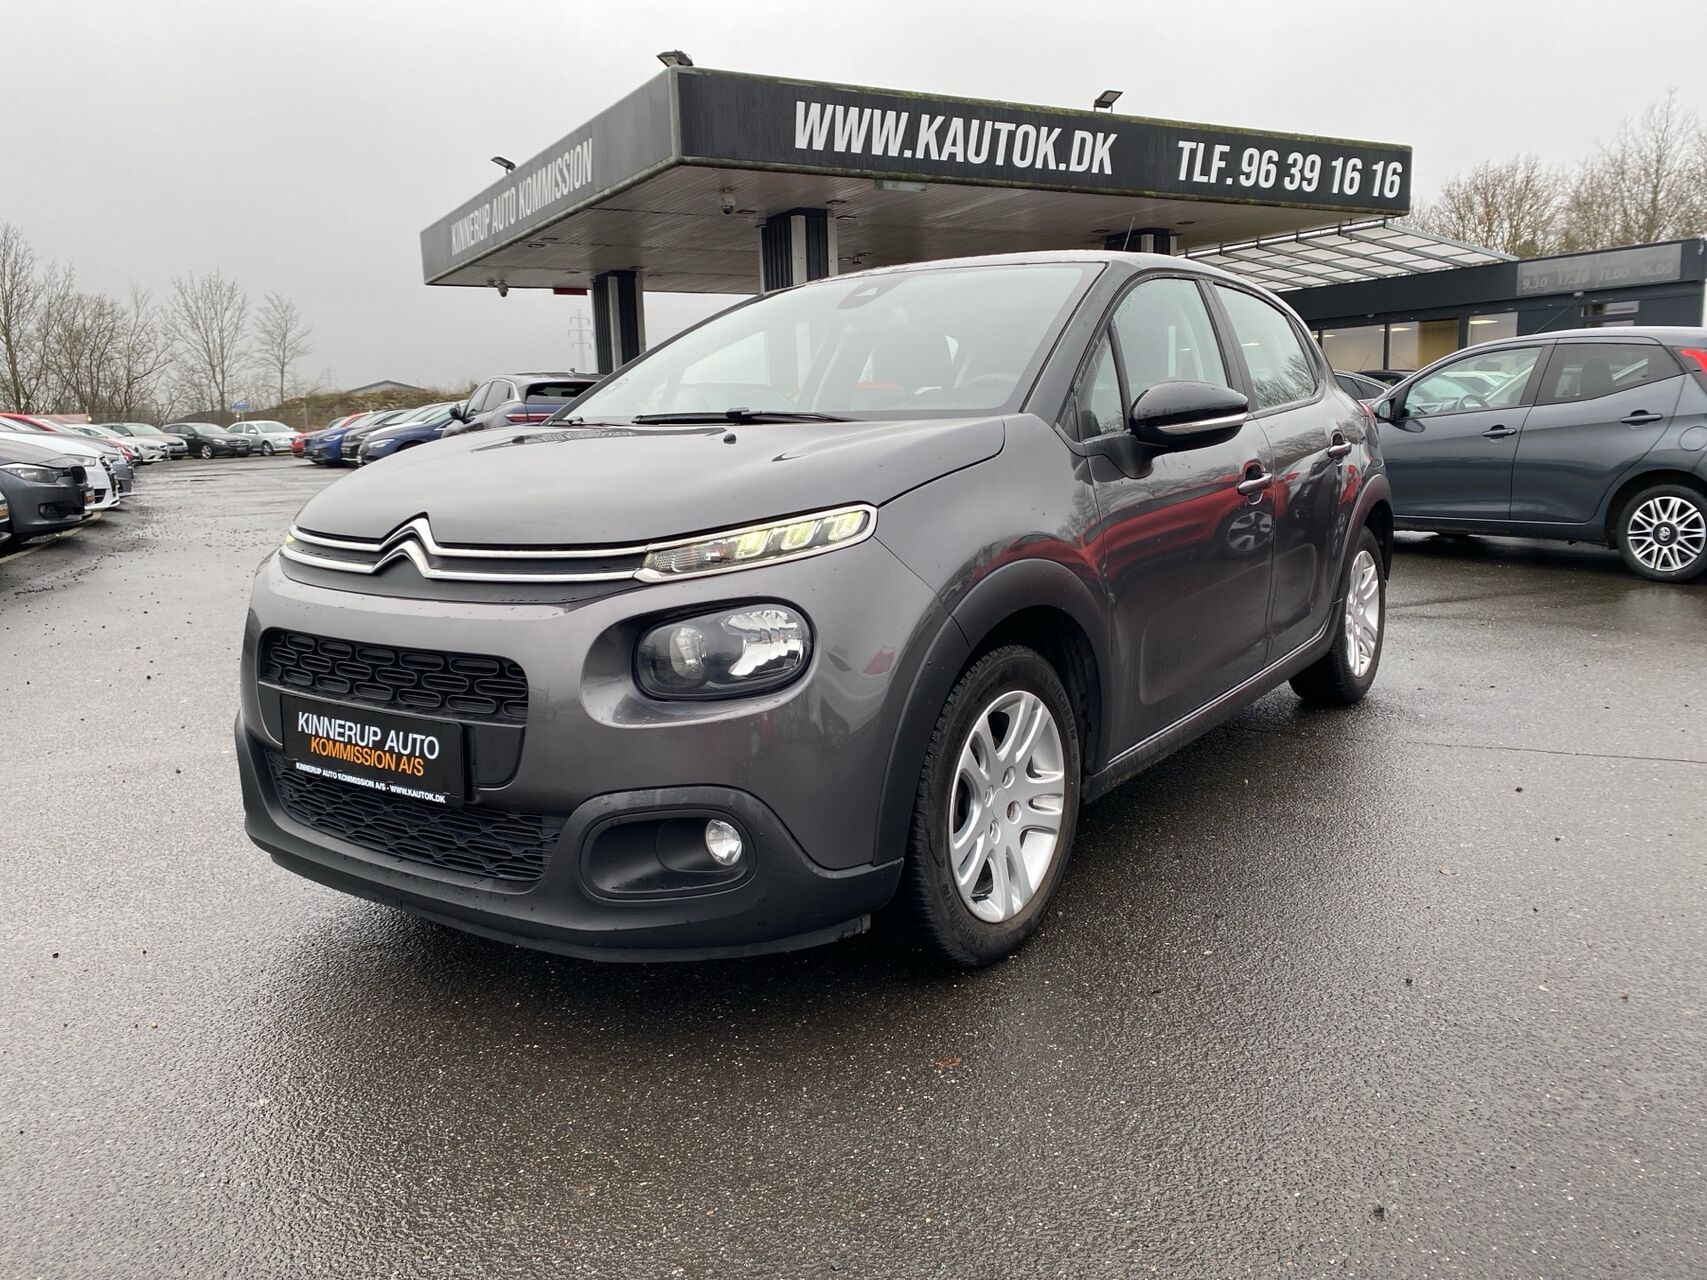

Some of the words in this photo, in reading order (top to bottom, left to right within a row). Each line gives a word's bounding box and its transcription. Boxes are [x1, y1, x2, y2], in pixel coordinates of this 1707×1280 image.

[795, 101, 1118, 175] WWW.KAUTOK.DK
[1178, 140, 1233, 185] TLF.
[1239, 148, 1279, 189] 96
[1284, 152, 1322, 193] 39
[1331, 157, 1362, 196] 16
[1372, 161, 1403, 199] 16
[452, 203, 491, 256] KINNERUP
[491, 187, 516, 234] AUTO
[518, 138, 593, 220] KOMMISSION
[298, 712, 381, 747] KINNERUP
[384, 730, 440, 760] AUTO
[311, 737, 396, 771] KOMMISSION
[398, 756, 424, 776] A/S
[295, 762, 322, 775] KINNERUP
[322, 769, 338, 780] AUTO
[338, 772, 375, 788] KOMMISSION
[375, 781, 386, 791] A/S
